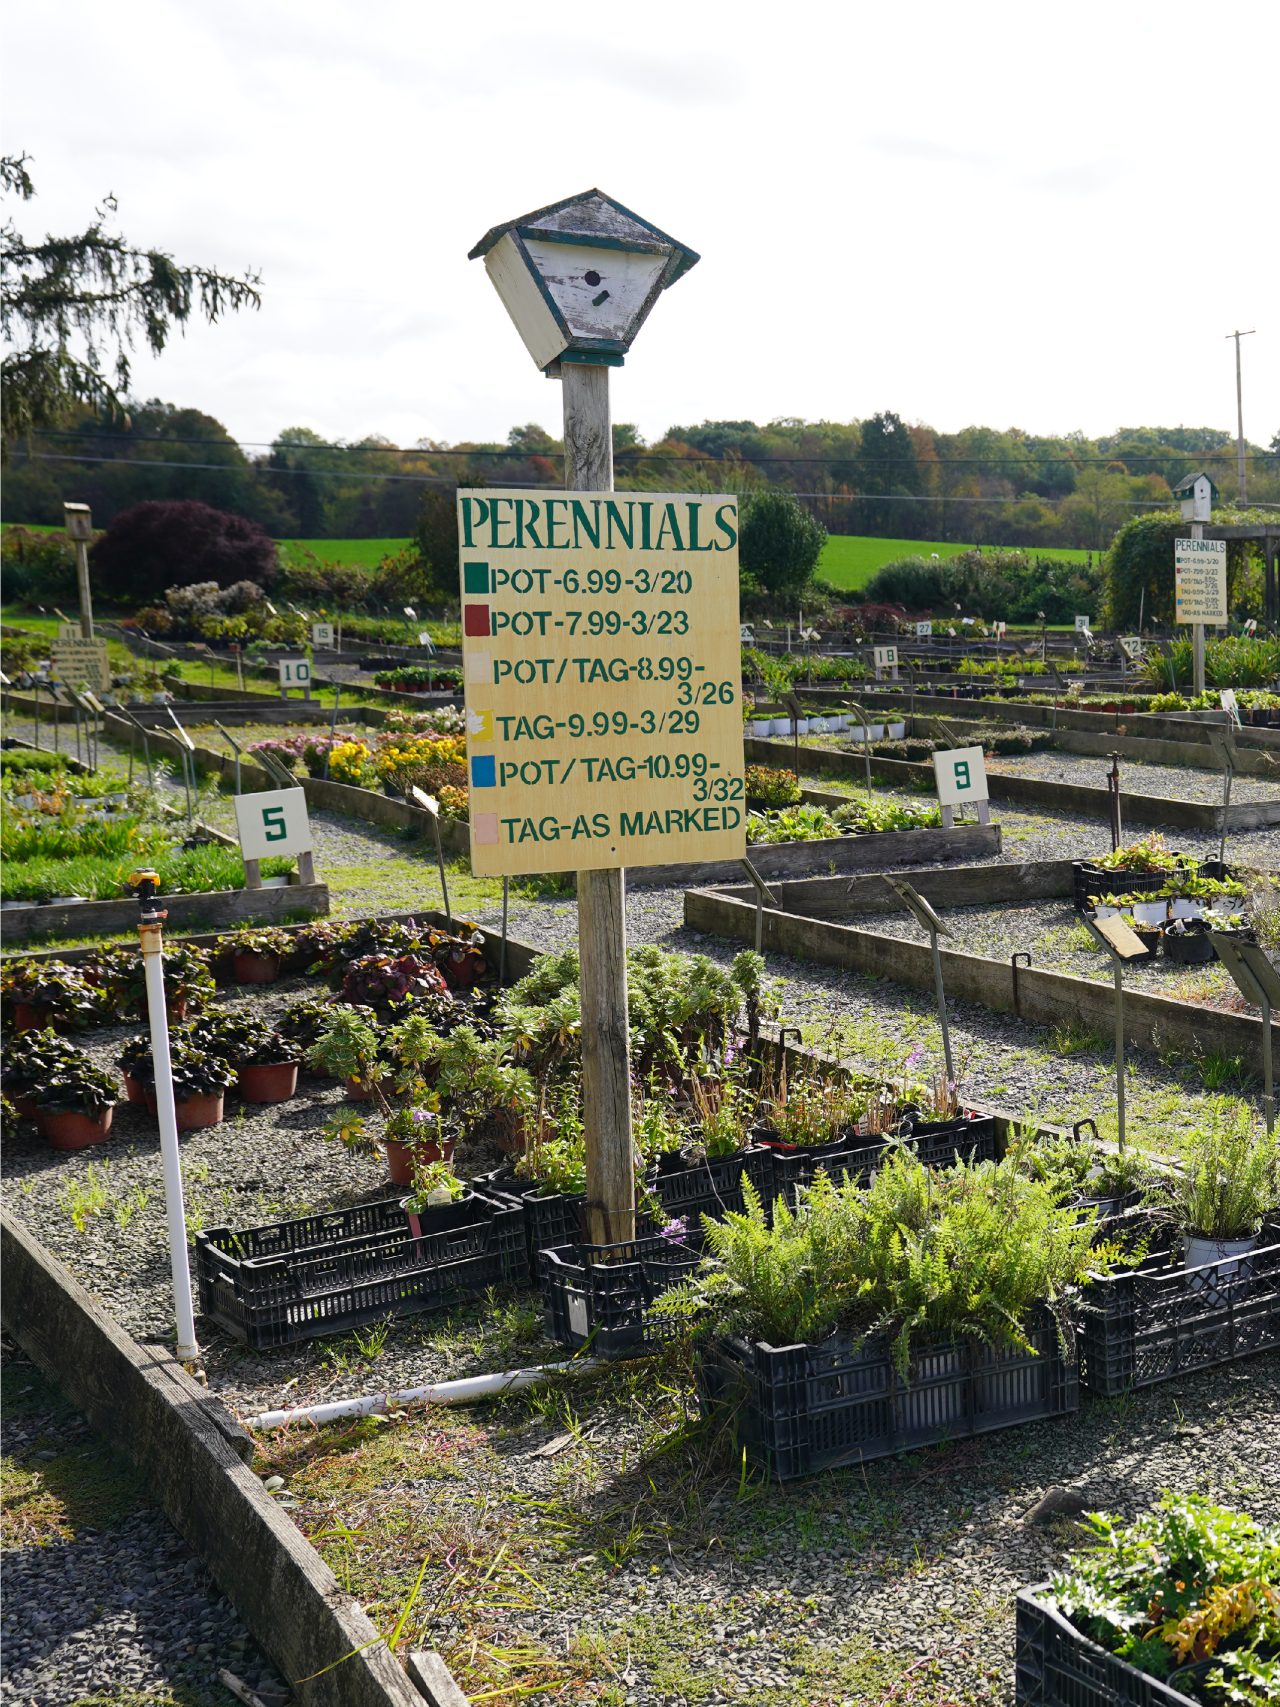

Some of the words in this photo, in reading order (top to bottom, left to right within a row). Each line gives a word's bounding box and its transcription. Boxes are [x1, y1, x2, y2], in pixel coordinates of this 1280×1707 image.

[460, 497, 737, 552] PERENNIALS
[1176, 540, 1225, 553] PERENNIALS
[490, 568, 693, 595] POT-6.99-3/20
[318, 628, 328, 638] 15
[490, 610, 689, 637] POT-7.99-3/23
[919, 624, 930, 633] 27
[879, 649, 894, 662] 18
[285, 664, 309, 681] 10
[676, 681, 734, 706] 3/26
[496, 709, 700, 742] TAG-9.99-3/29
[954, 761, 971, 790] 9
[692, 777, 744, 802] 3/32
[261, 806, 287, 842] 5
[500, 813, 610, 844] TAG-AS
[619, 805, 741, 837] MARKED
